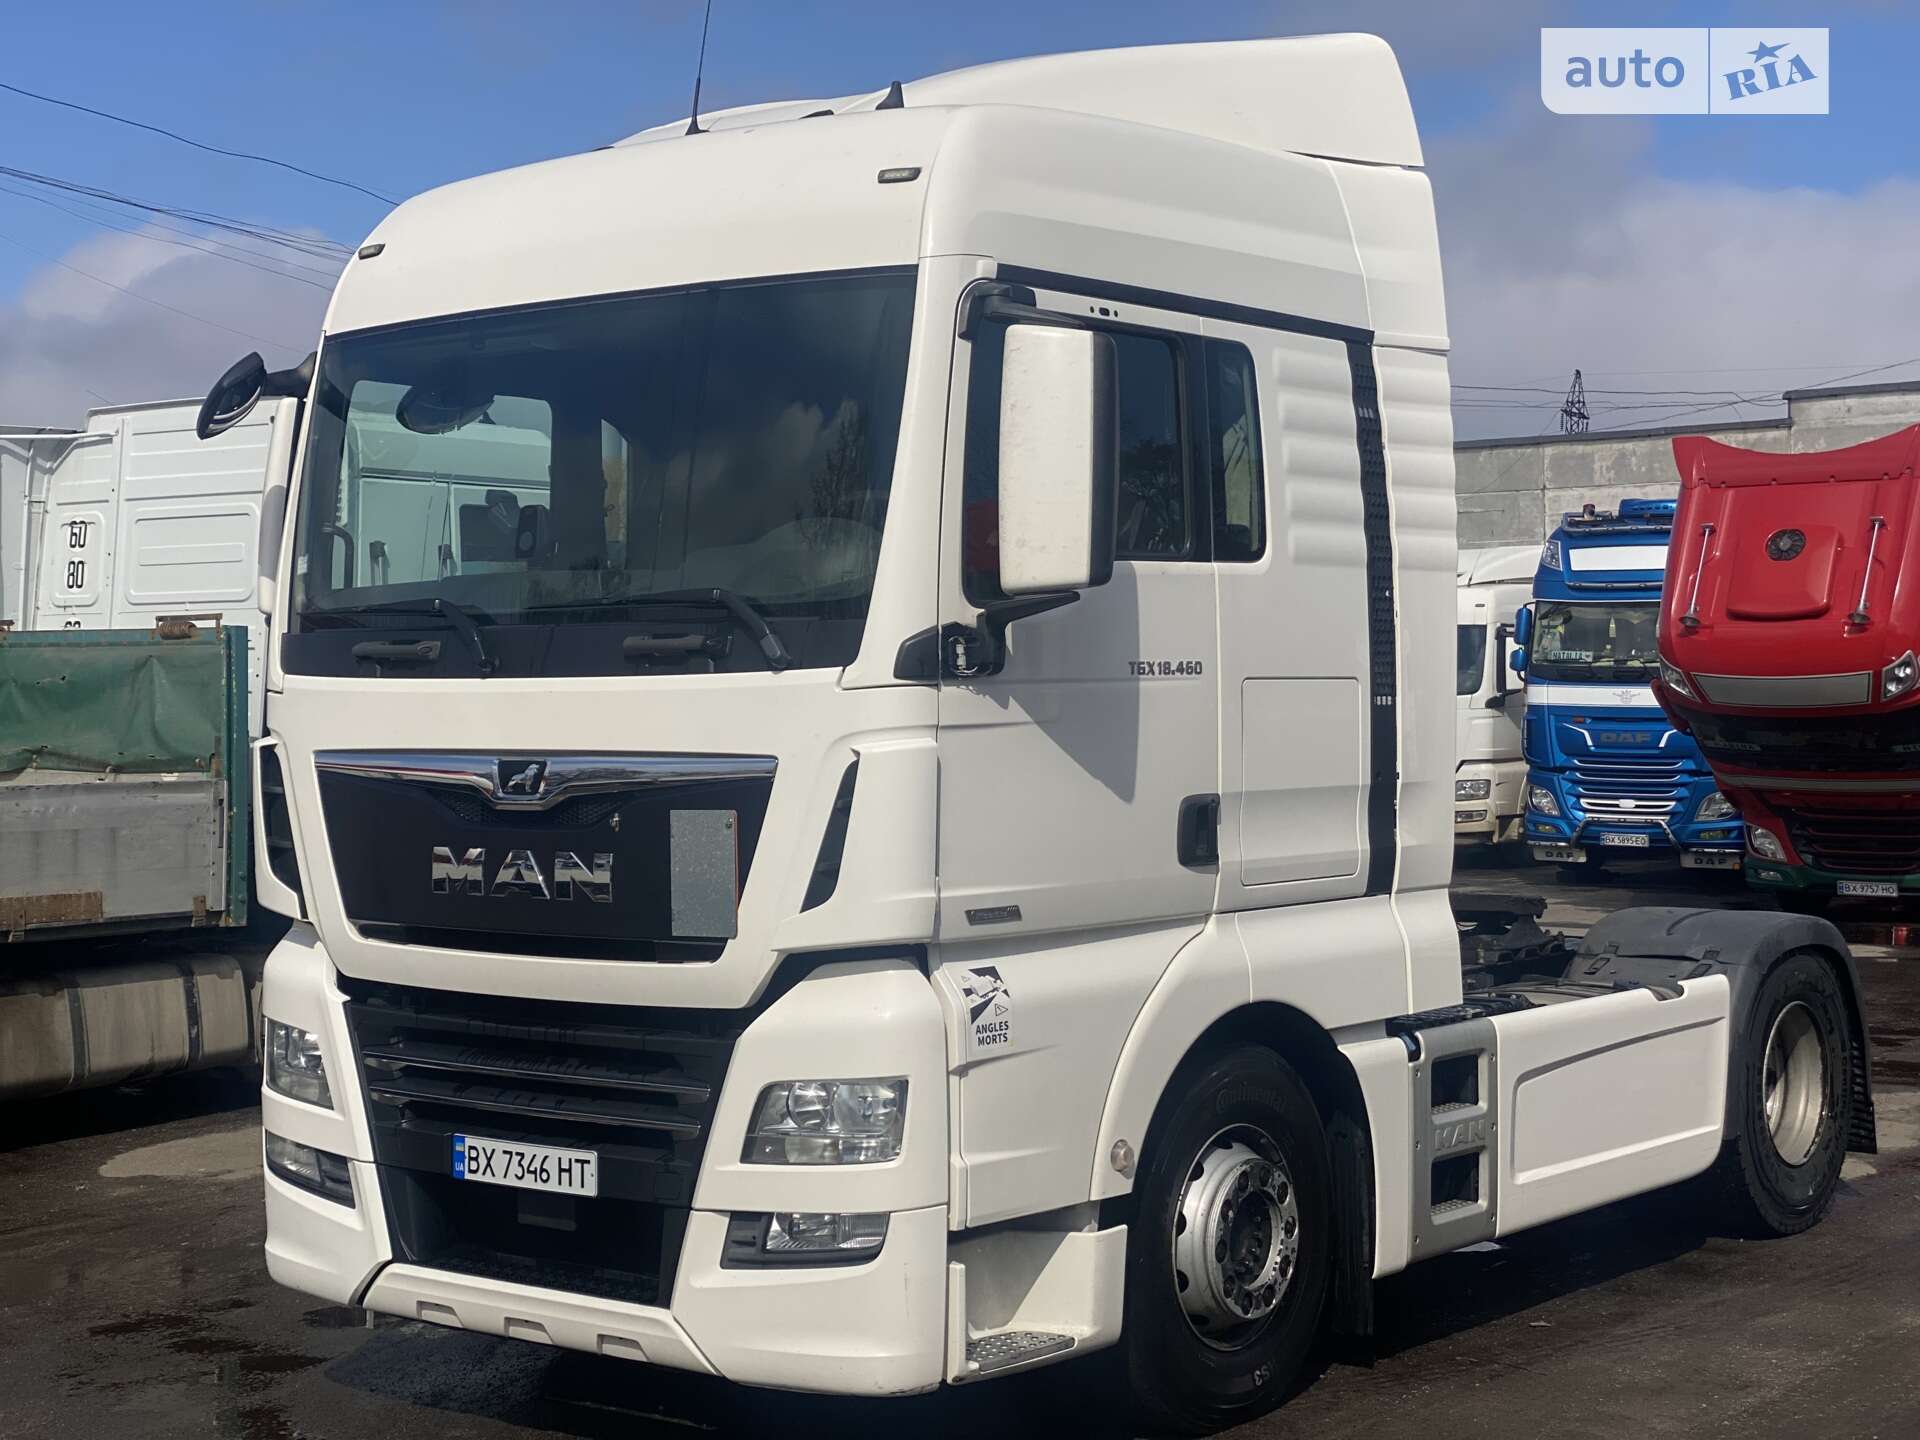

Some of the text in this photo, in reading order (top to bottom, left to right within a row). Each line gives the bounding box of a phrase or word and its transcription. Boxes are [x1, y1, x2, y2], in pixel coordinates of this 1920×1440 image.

[69, 520, 88, 549] 60
[67, 560, 85, 589] 80
[1600, 732, 1651, 744] DAF
[1545, 850, 1575, 859] DAF
[1694, 856, 1728, 865] DAF
[431, 846, 614, 903] MAN
[1844, 883, 1858, 893] BX
[1860, 884, 1879, 895] 9757
[975, 1021, 1009, 1036] ANGLES
[977, 1032, 1009, 1047] MORTS
[1434, 1119, 1487, 1151] MAN
[455, 1161, 464, 1172] UA
[467, 1144, 592, 1189] BX 7346 HT
